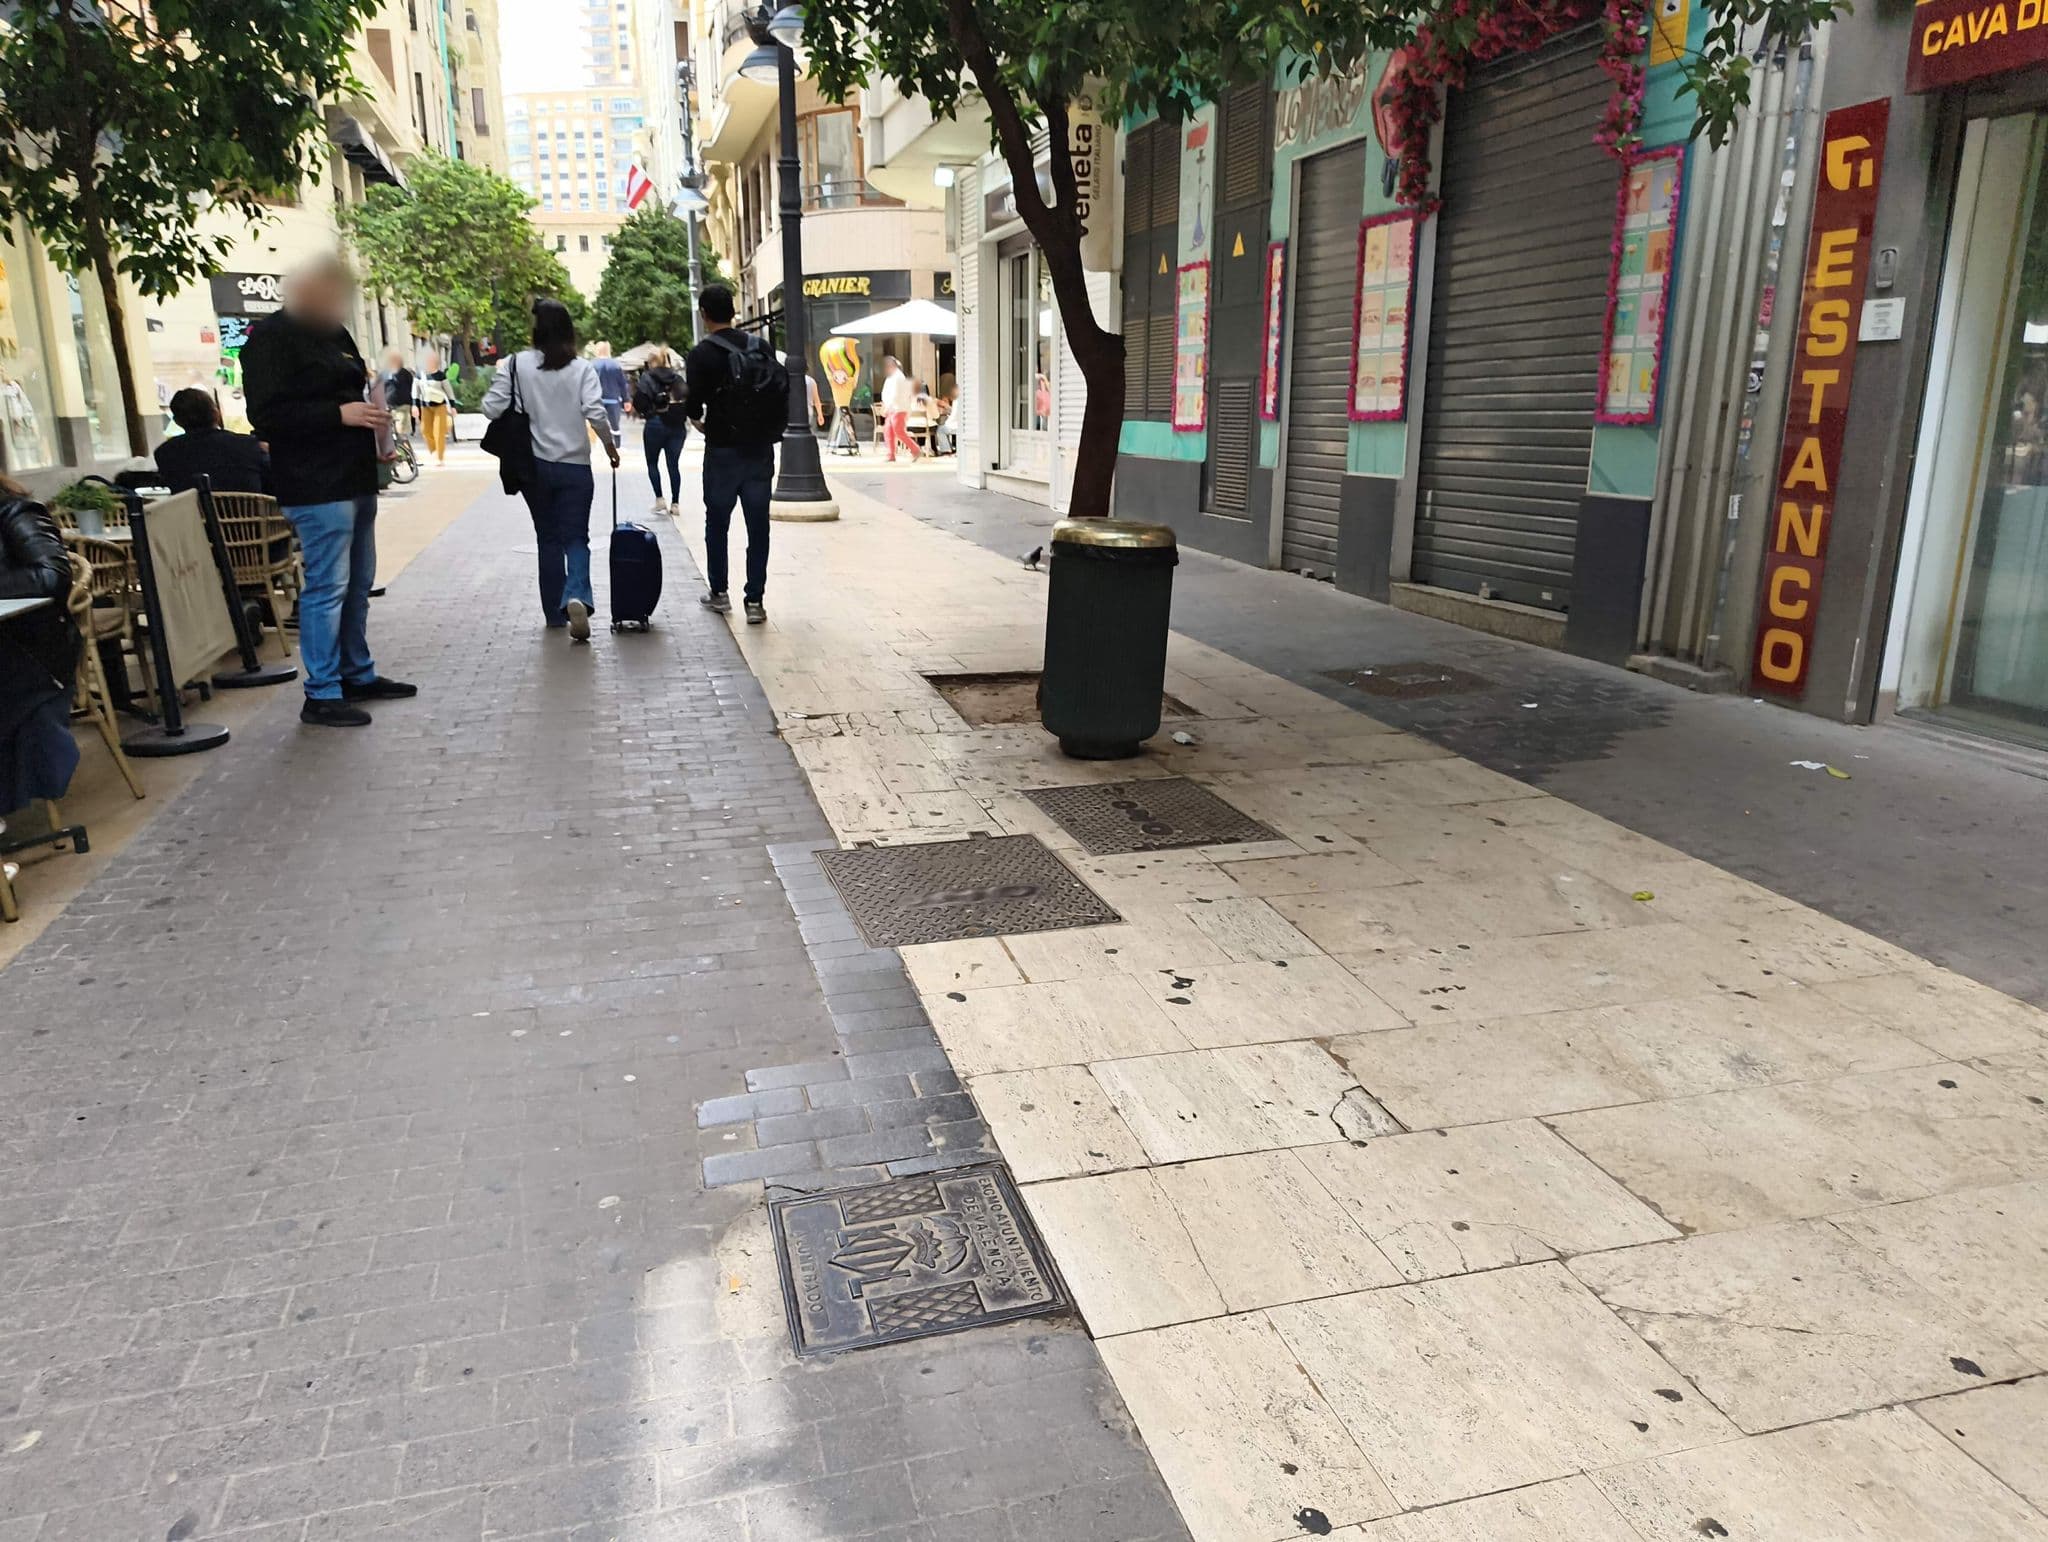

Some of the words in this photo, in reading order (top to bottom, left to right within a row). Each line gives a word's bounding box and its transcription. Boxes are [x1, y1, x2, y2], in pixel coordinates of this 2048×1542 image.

[1922, 3, 2008, 56] CAVA
[1071, 123, 1093, 238] veneta
[802, 277, 871, 297] GRANIER
[963, 1196, 980, 1214] DE
[996, 1212, 1044, 1301] AYUNTAMIENTO
